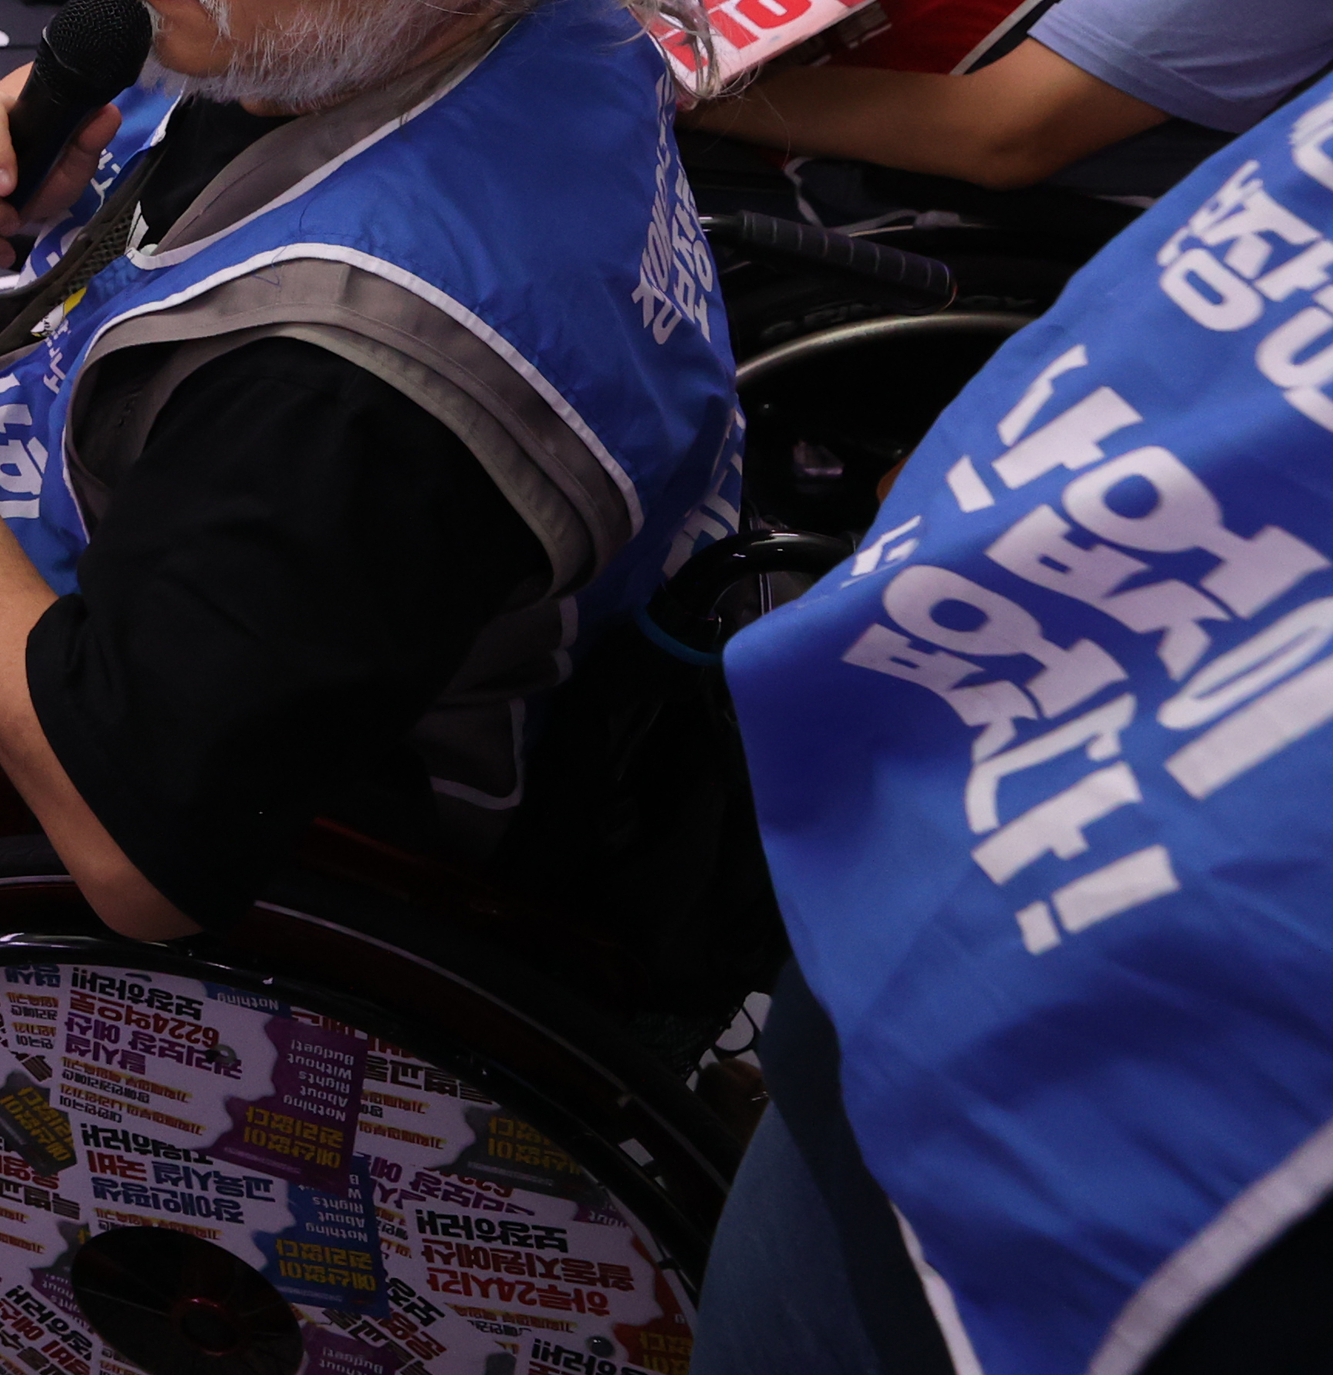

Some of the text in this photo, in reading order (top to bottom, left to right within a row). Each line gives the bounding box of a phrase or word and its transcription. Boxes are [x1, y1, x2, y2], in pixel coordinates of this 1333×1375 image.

[71, 966, 204, 1021] 보장하라!!
[64, 1011, 120, 1044] 예산
[69, 990, 219, 1049] 6224억으로
[65, 1034, 146, 1076] 탈시설
[287, 1053, 352, 1081] Without
[290, 1039, 355, 1066] Budget!
[298, 1071, 350, 1094] Rights
[300, 1085, 348, 1107] About
[283, 1094, 346, 1122] Nothing
[243, 1104, 344, 1147] 권리없다
[242, 1127, 342, 1169] 예산없이
[86, 1150, 275, 1202] 교육시설 국비
[92, 1177, 244, 1224] 장애인평생
[312, 1196, 363, 1214] Rights
[305, 1223, 368, 1243] Nothing
[317, 1211, 365, 1228] About
[414, 1209, 568, 1252] 보장하라!
[276, 1239, 373, 1270] 권리없다
[421, 1238, 634, 1292] 활동지원예산
[278, 1260, 377, 1292] 예산없이
[426, 1266, 609, 1317] 하루24시간
